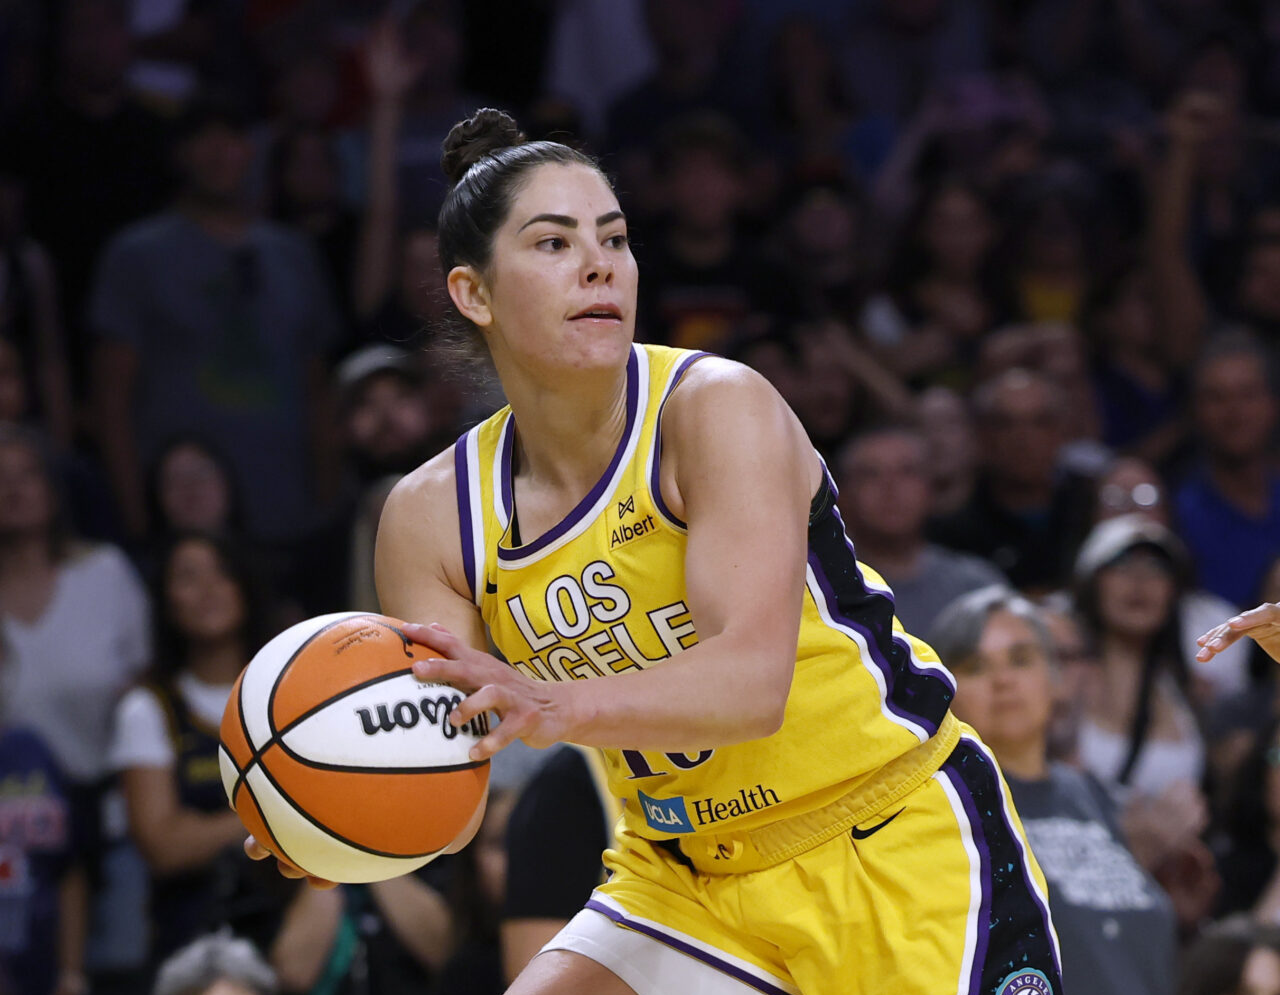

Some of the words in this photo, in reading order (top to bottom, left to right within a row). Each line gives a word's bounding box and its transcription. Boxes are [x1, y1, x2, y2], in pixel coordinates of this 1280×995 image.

[611, 514, 655, 548] Albert
[506, 560, 631, 653] LOS
[513, 600, 700, 682] NGELE
[644, 800, 685, 826] UCLA
[692, 784, 782, 827] Health
